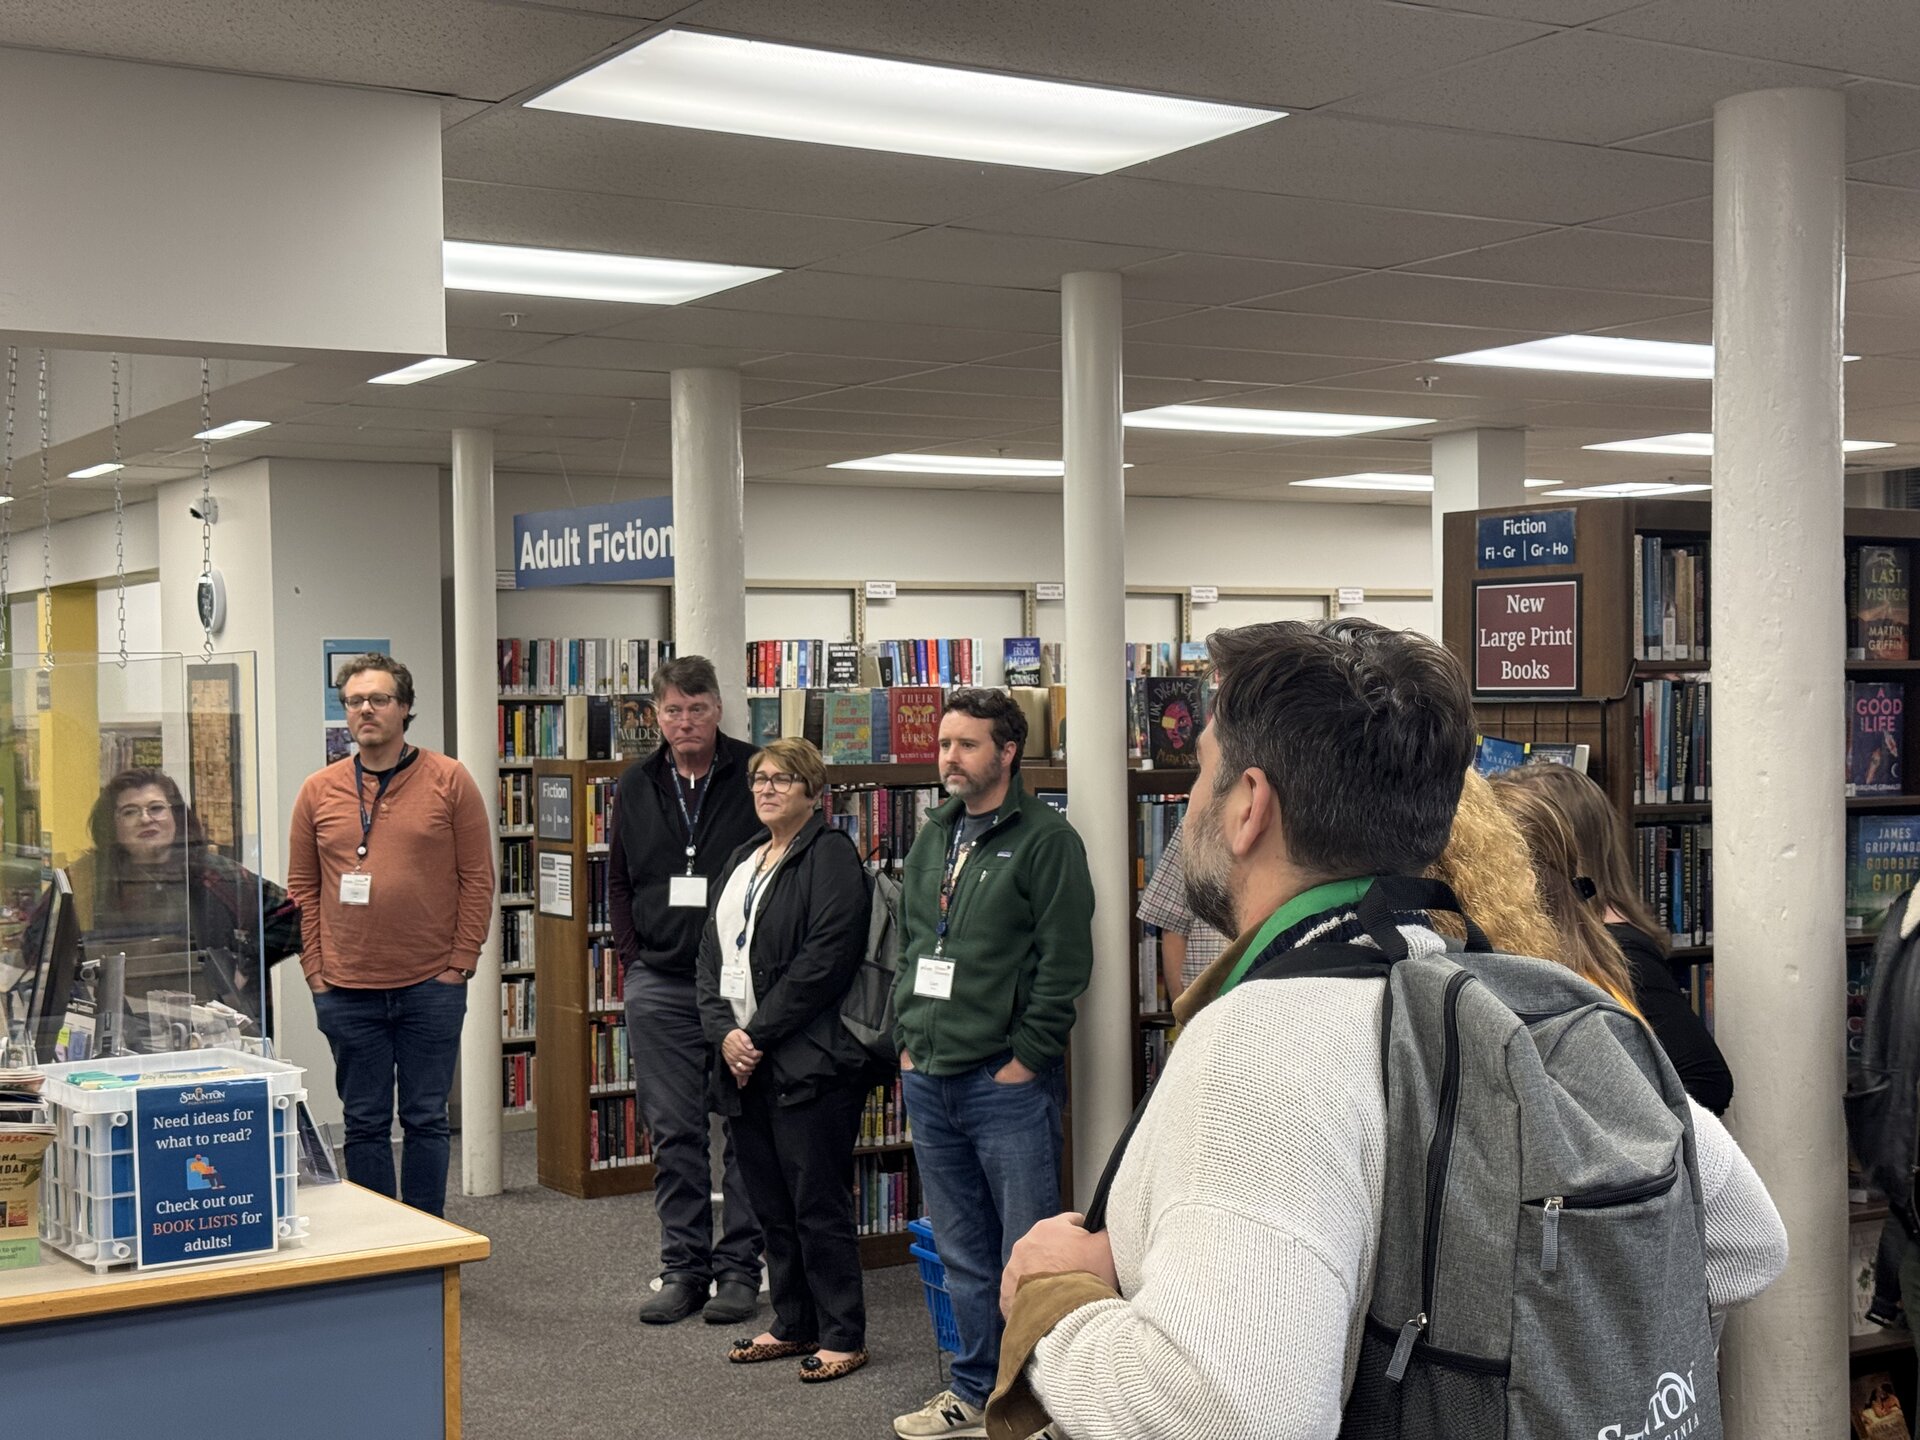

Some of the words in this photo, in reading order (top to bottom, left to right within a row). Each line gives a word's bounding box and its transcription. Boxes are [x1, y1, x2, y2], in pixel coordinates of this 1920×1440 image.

[1502, 518, 1547, 536] Fiction
[519, 527, 581, 571] Adult
[588, 518, 674, 564] Fiction
[1485, 547, 1495, 560] Fi
[1503, 545, 1516, 558] Gr
[1530, 543, 1544, 557] Gr
[1552, 542, 1569, 556] Ho
[1871, 568, 1902, 583] LAST
[1865, 588, 1908, 601] VISITOR
[1506, 594, 1545, 614] New
[1480, 627, 1525, 652] Large
[1530, 625, 1573, 647] Print
[1501, 659, 1550, 681] Books
[901, 694, 934, 703] THEIR
[1877, 688, 1885, 698] A
[1856, 698, 1903, 715] GOOD
[1865, 715, 1896, 732] LIFE
[542, 782, 568, 799] Fiction
[1878, 828, 1912, 839] JAMES
[1865, 841, 1920, 854] GRIPPANDO
[1866, 857, 1919, 870] GOODBYE
[1659, 872, 1667, 898] GONE
[1659, 903, 1667, 930] AGAI
[152, 1115, 189, 1130] Need
[193, 1112, 230, 1125] ideas
[233, 1109, 254, 1121] for
[155, 1134, 192, 1150] what
[195, 1135, 210, 1146] to
[213, 1128, 252, 1144] read?
[156, 1198, 199, 1214] Check
[202, 1196, 226, 1209] out
[229, 1193, 254, 1206] our
[152, 1218, 195, 1236] BOOK
[199, 1213, 238, 1230] LISTS
[241, 1211, 263, 1225] for
[184, 1234, 232, 1252] adults!
[940, 1404, 967, 1426] N
